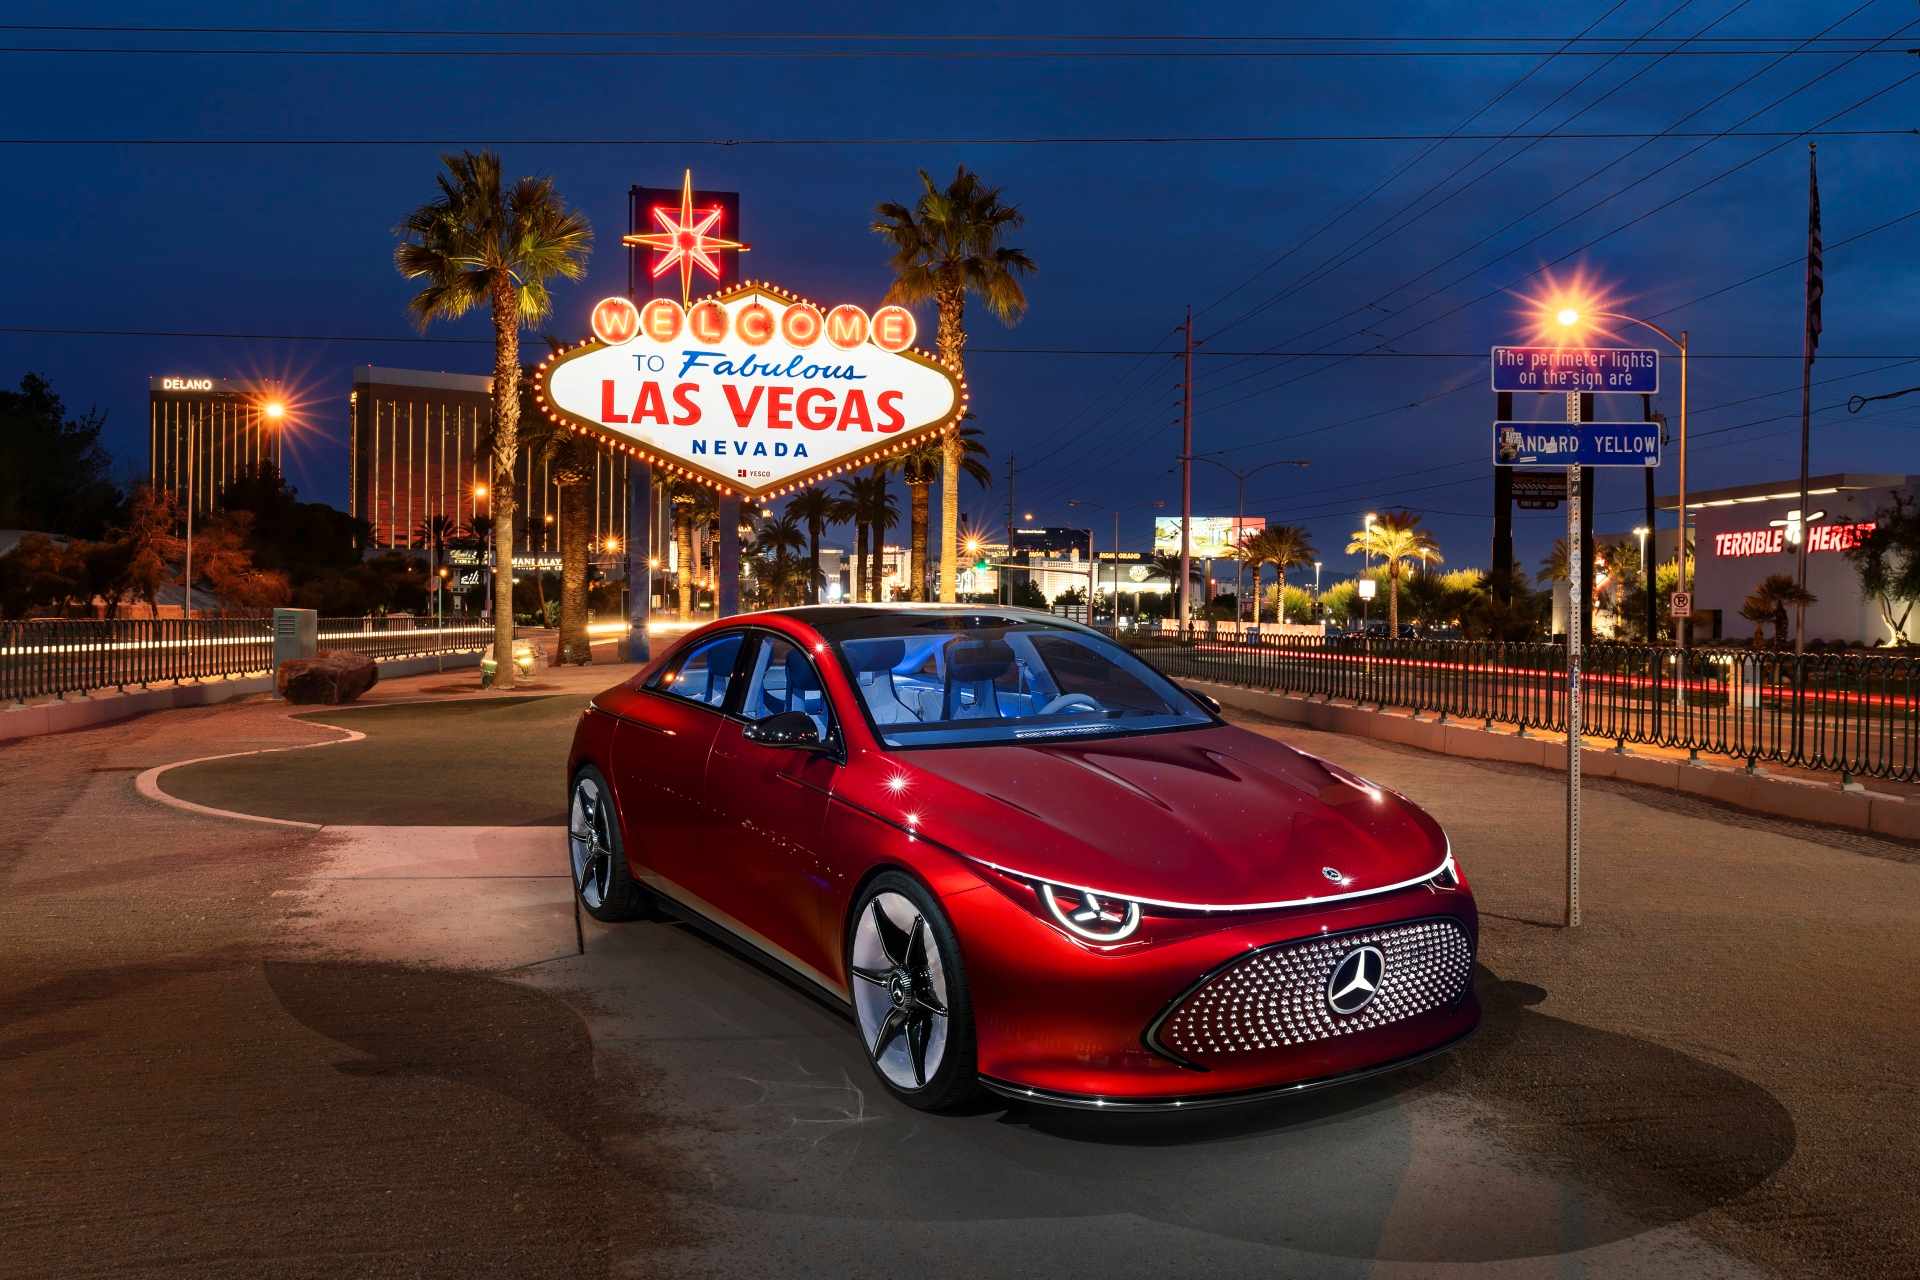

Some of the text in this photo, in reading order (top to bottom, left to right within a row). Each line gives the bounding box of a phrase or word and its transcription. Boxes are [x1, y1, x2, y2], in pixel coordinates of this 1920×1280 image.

[598, 304, 906, 346] WELCOME
[632, 350, 867, 381] TO Fabulous
[1498, 350, 1654, 373] The perimeter lights
[164, 379, 212, 390] DELANO
[1519, 370, 1632, 390] on the sign are
[601, 379, 906, 434] LAS VEGAS
[692, 440, 809, 458] NEVADA
[1498, 435, 1579, 453] ANDARD
[1594, 436, 1656, 453] YELLOW
[1715, 528, 1784, 557] TERRIBLE
